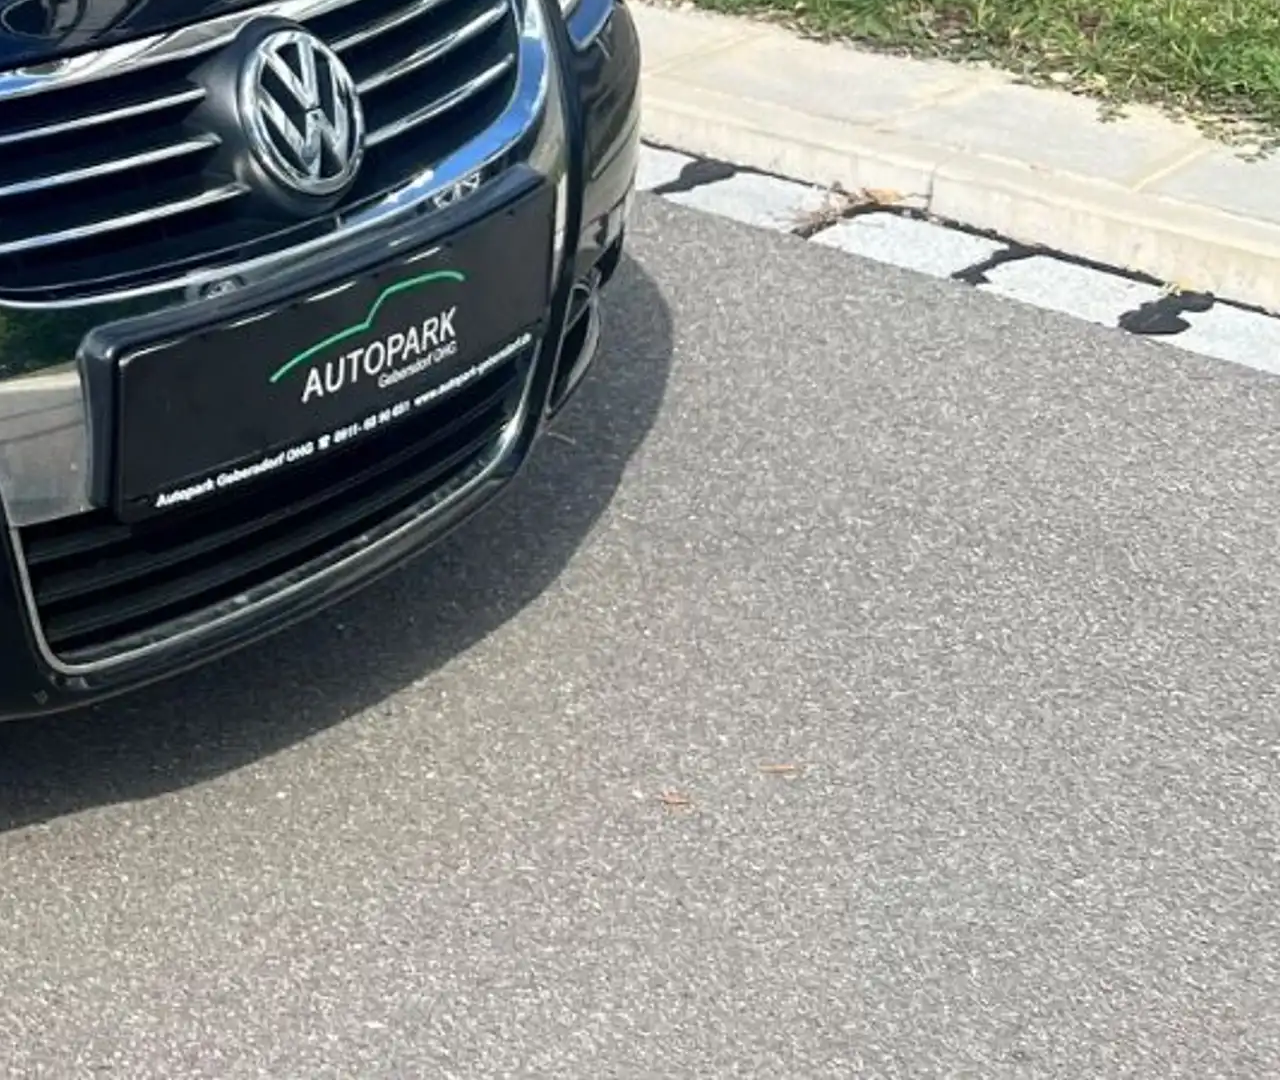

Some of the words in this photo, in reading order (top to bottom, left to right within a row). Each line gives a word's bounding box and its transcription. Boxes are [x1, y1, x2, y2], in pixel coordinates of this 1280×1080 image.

[301, 305, 457, 404] AUTOPARK
[377, 352, 432, 388] Gebersdorf
[154, 478, 216, 508] Autopark
[216, 451, 286, 487] Gebersdorf
